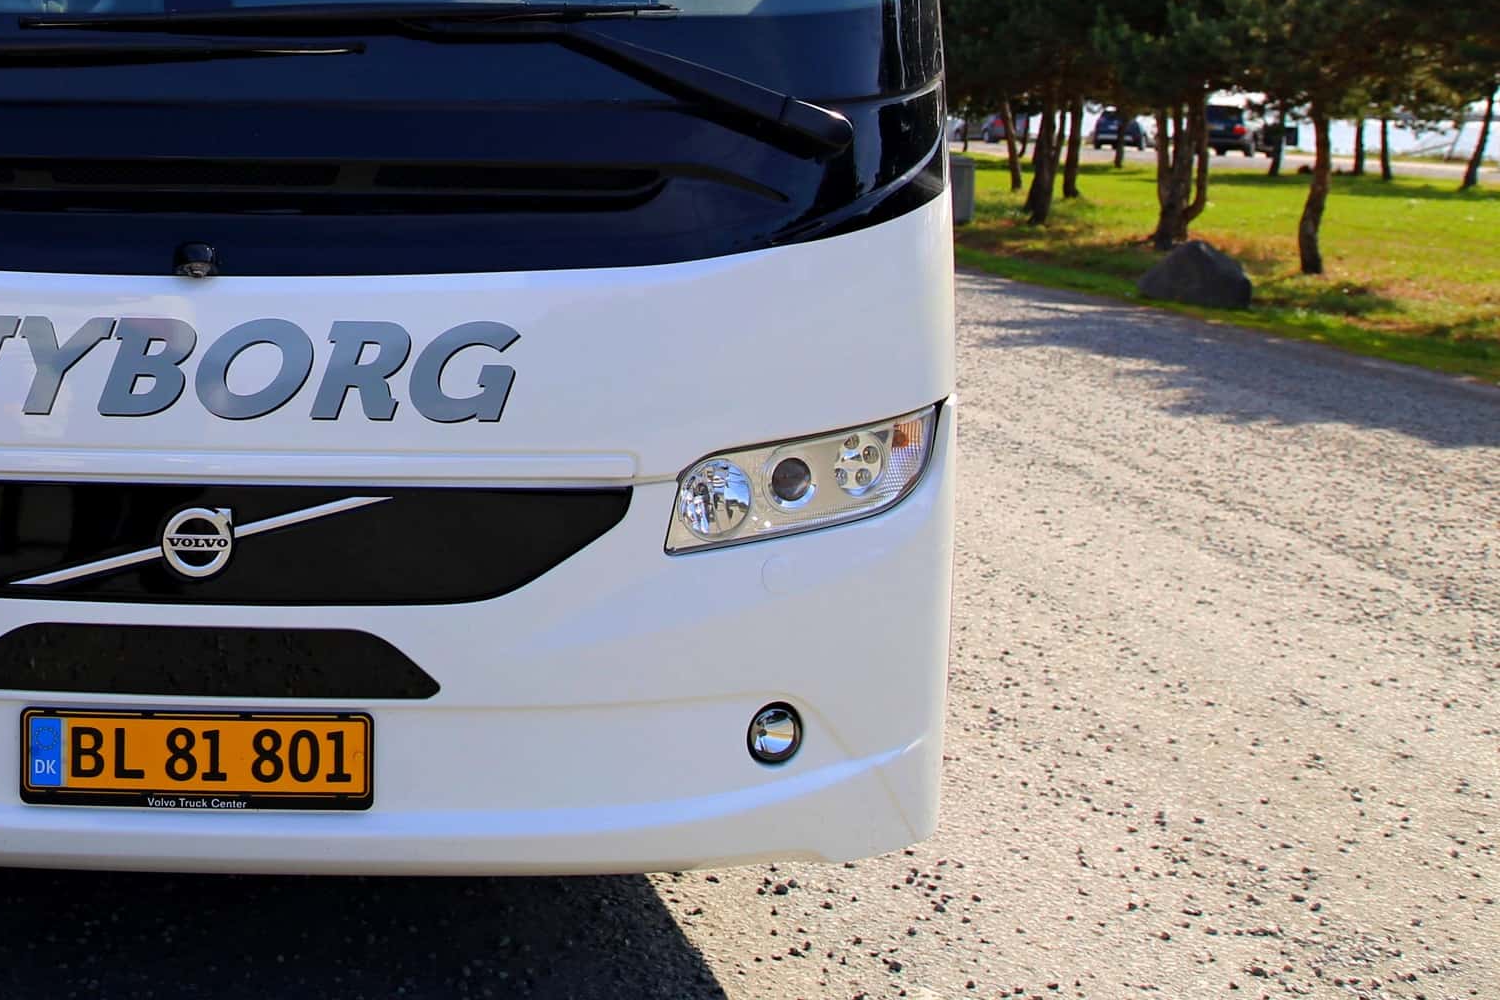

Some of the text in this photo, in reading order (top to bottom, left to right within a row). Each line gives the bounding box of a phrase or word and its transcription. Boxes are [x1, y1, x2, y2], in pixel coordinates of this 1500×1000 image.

[166, 537, 229, 548] VOLVO
[70, 726, 352, 783] BL 81 801
[34, 759, 57, 775] DK
[147, 797, 247, 809] Volvo Truck Center
